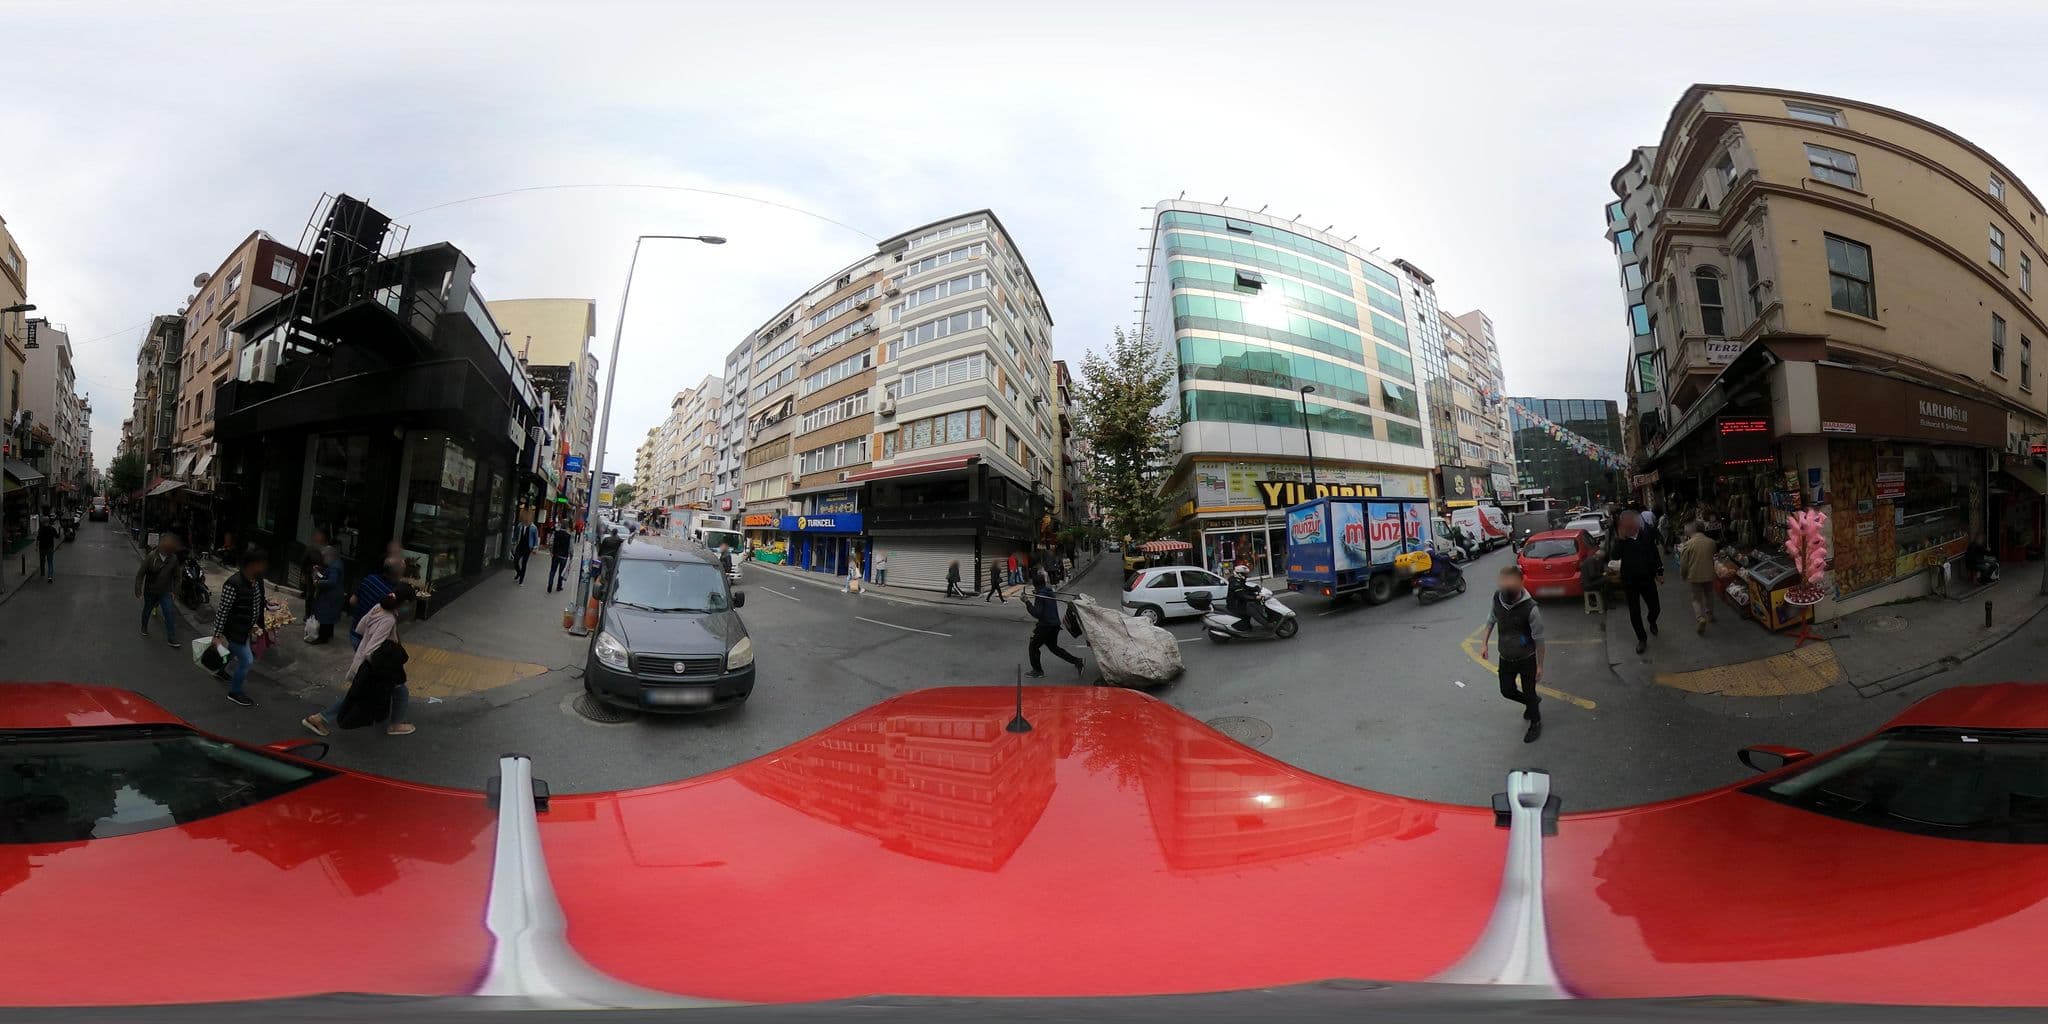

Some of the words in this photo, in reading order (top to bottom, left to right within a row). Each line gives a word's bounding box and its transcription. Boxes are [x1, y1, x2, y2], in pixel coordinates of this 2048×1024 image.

[807, 518, 836, 528] TURKCELL
[1292, 519, 1321, 537] munzur
[1345, 521, 1422, 544] munzur
